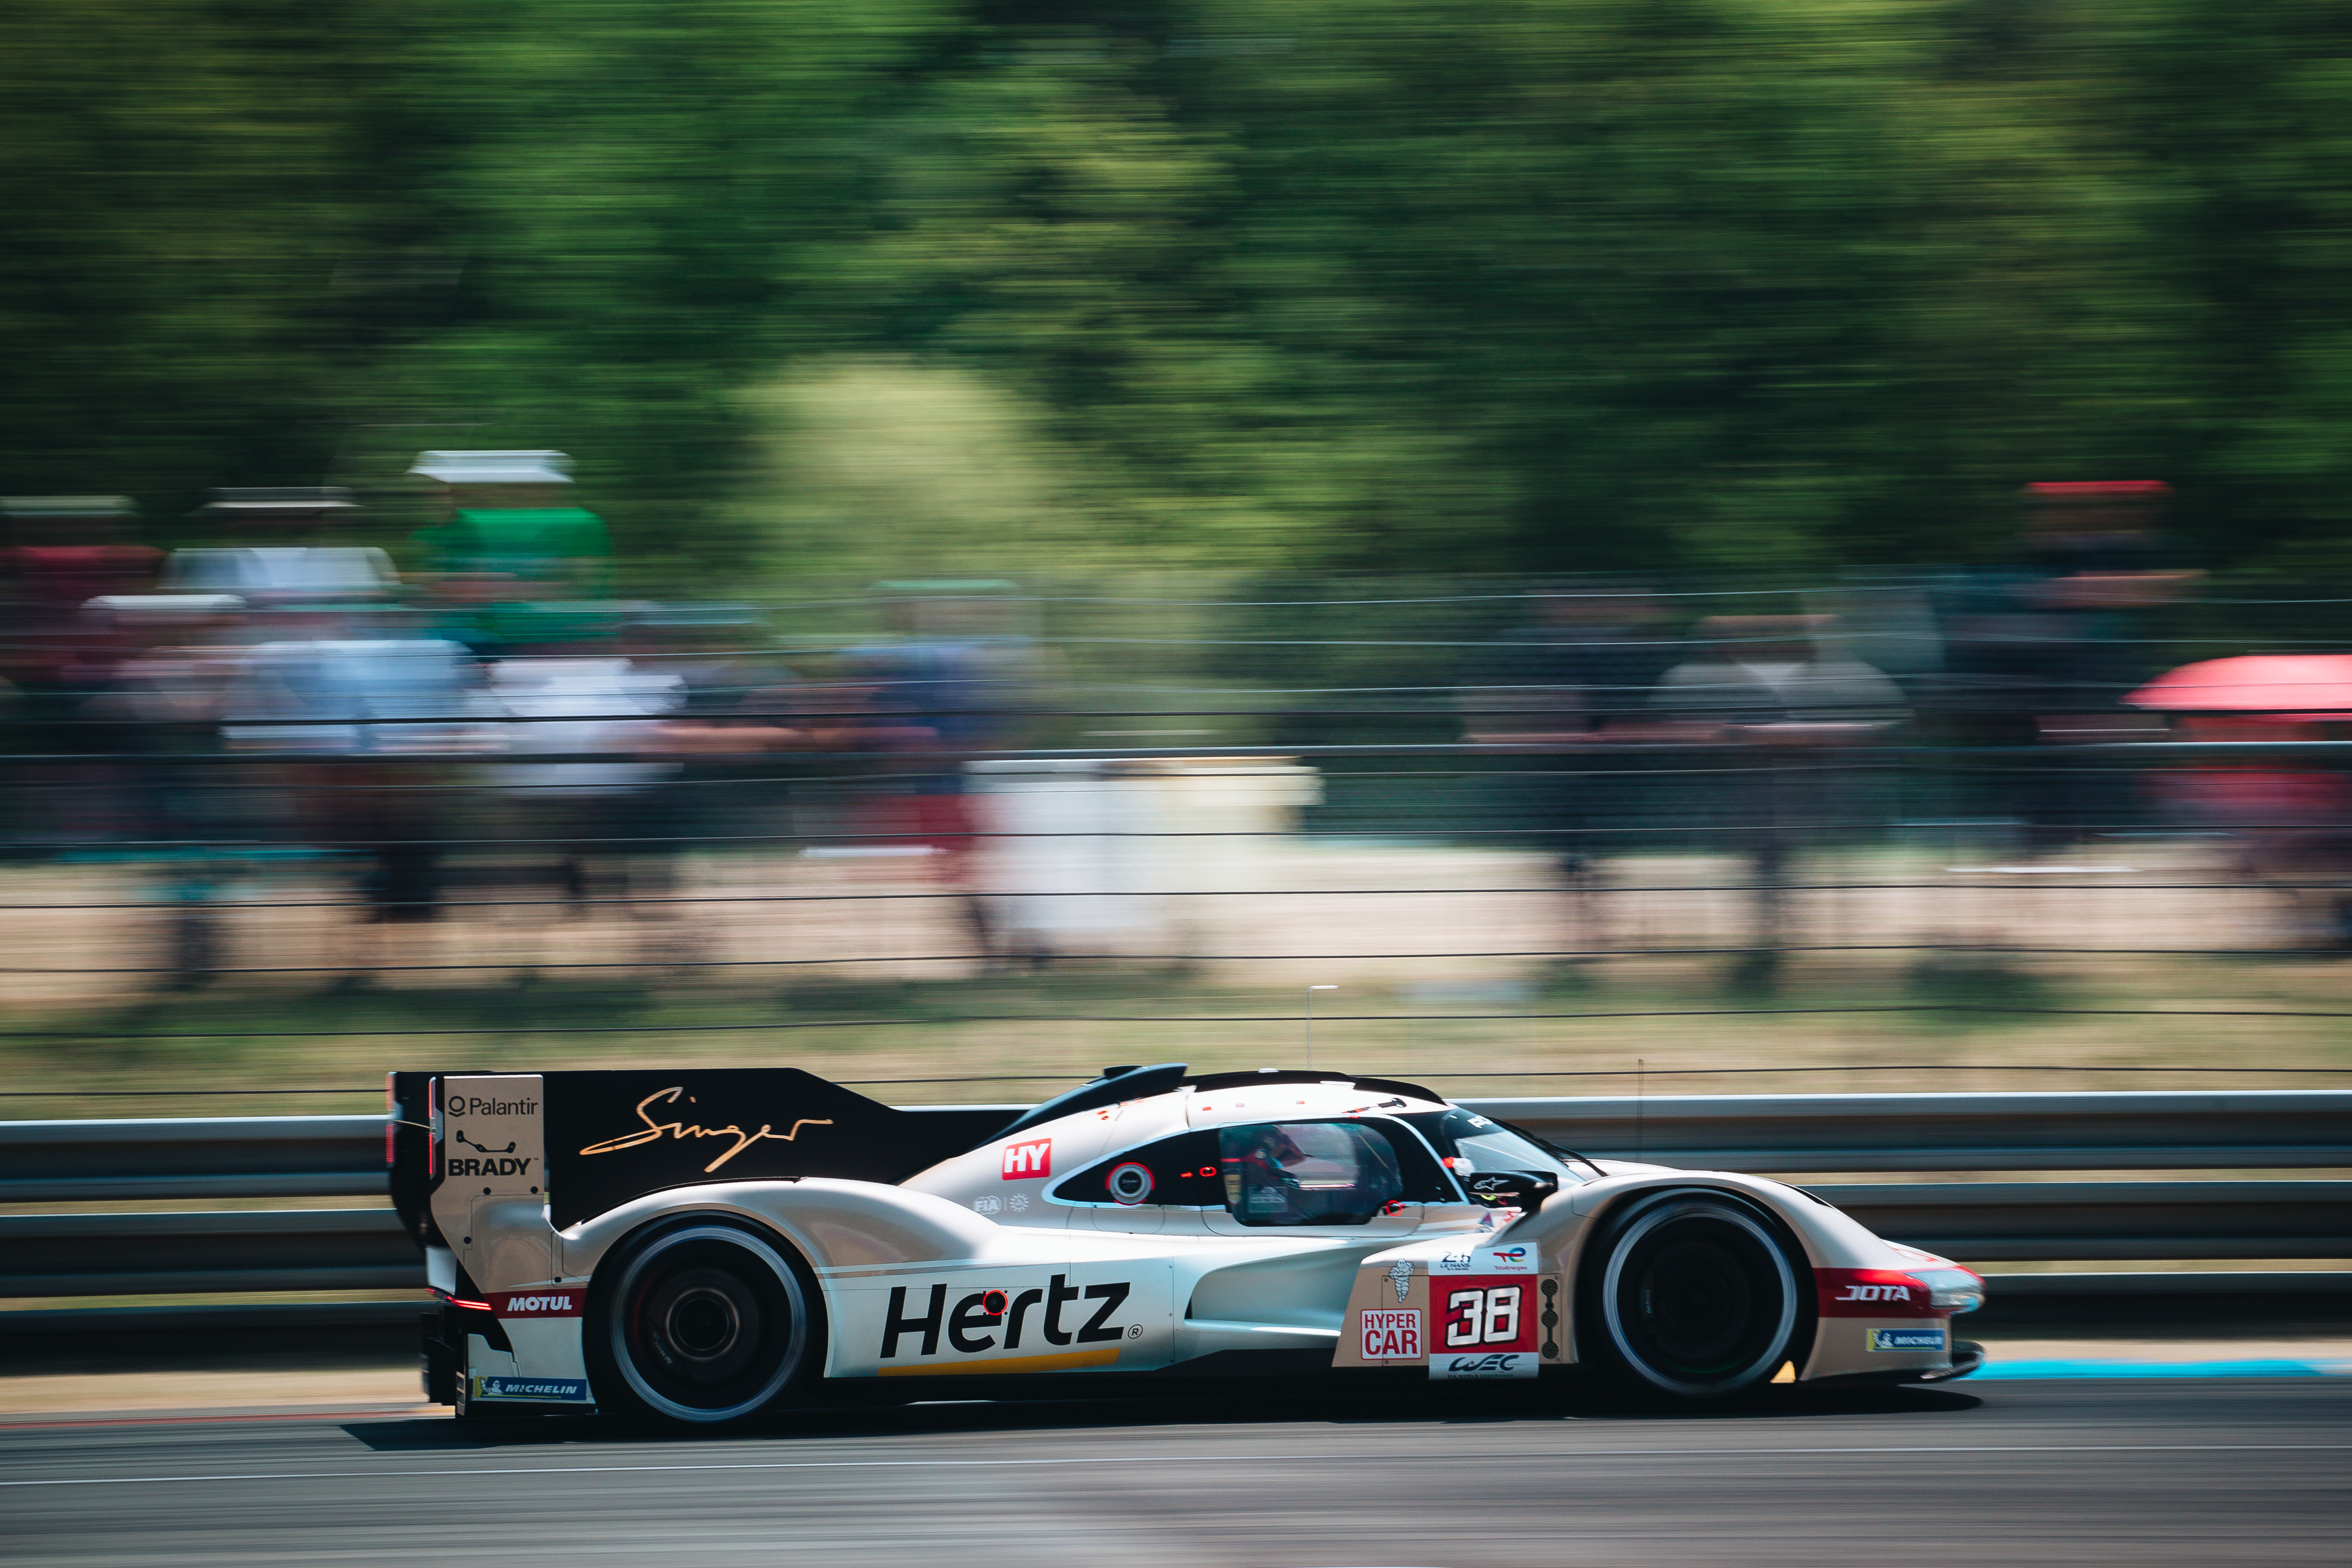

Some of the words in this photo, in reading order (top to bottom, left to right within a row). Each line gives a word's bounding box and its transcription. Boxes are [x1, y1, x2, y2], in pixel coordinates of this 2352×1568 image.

[469, 1097, 539, 1115] Palantir
[579, 1087, 834, 1172] Singer
[448, 1157, 532, 1176] BRADY
[1004, 1143, 1050, 1173] HY
[1834, 1285, 1911, 1301] JOTA
[507, 1296, 572, 1311] MOTUL
[880, 1273, 1131, 1359] Hertz
[1364, 1313, 1416, 1329] HYPER
[1445, 1284, 1522, 1349] 38
[1364, 1329, 1417, 1355] CAR
[1448, 1354, 1520, 1371] WEC
[505, 1384, 578, 1394] MICHELIN
